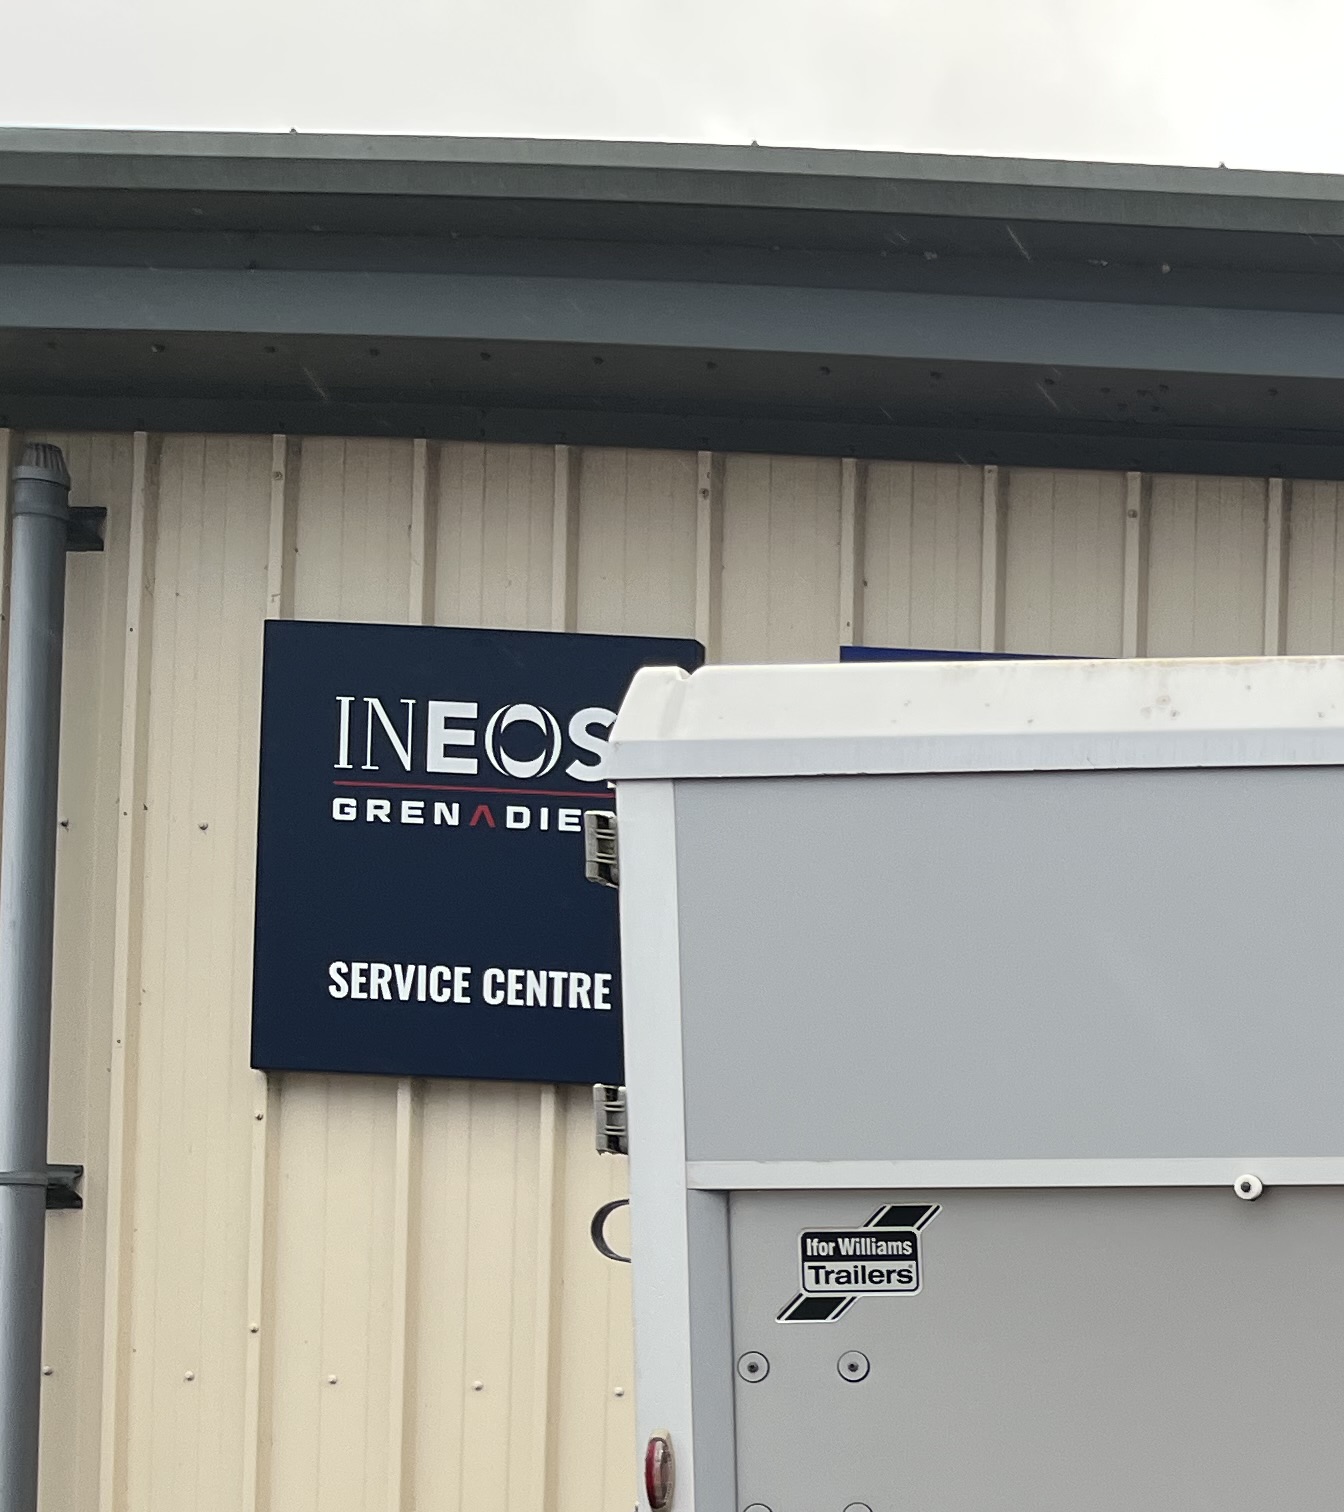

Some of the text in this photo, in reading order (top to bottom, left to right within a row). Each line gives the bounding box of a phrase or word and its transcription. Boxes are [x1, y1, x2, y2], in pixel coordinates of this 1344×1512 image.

[333, 696, 617, 782] INEOS
[332, 797, 614, 832] GRENADIE
[328, 961, 612, 1010] SERVICE CENTRE
[806, 1237, 913, 1256] Ifor Williams
[807, 1264, 913, 1285] Trailers
